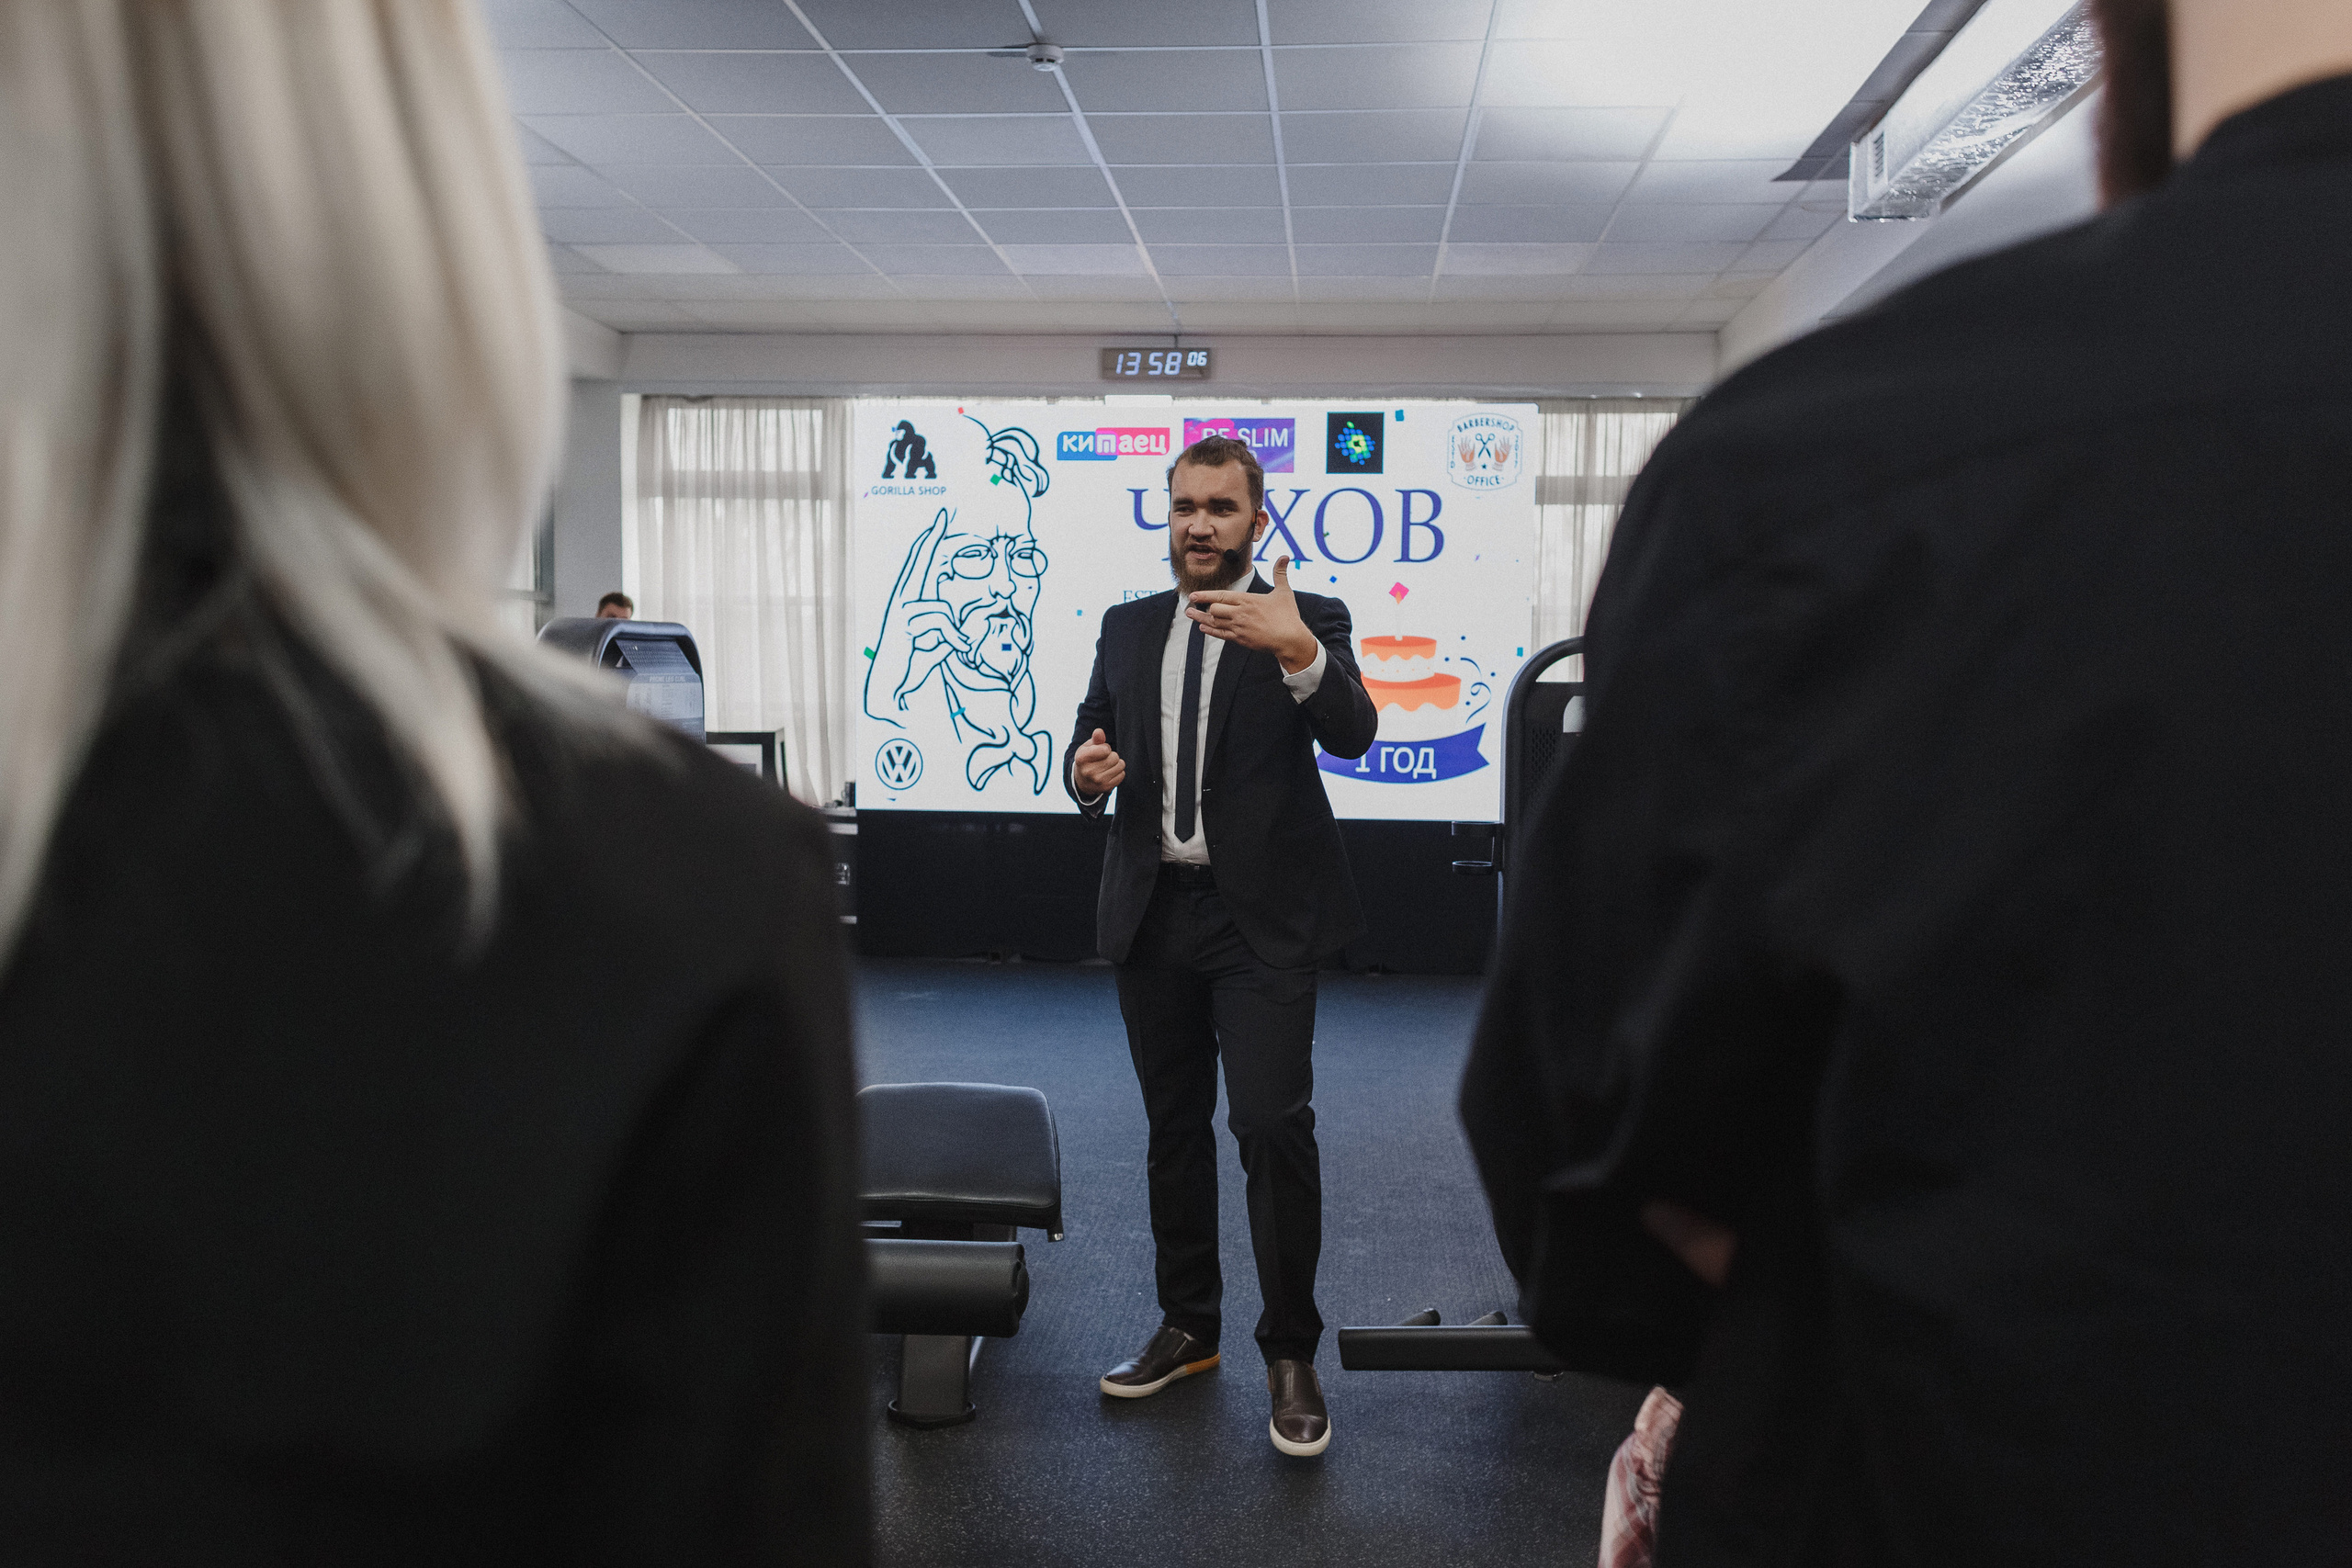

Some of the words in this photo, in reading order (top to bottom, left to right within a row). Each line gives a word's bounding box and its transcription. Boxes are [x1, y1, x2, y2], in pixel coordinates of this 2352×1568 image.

[1115, 352, 1142, 376] 13
[1148, 352, 1182, 376] 58
[1186, 351, 1208, 367] 06
[1456, 417, 1515, 433] BARBERSHOP
[1238, 427, 1289, 448] SLIM
[871, 485, 916, 496] GORILLA
[919, 485, 947, 496] SHOP
[1466, 474, 1501, 487] OFFICE
[1125, 487, 1445, 565] ЧХОВ
[1380, 746, 1437, 780] ГОД
